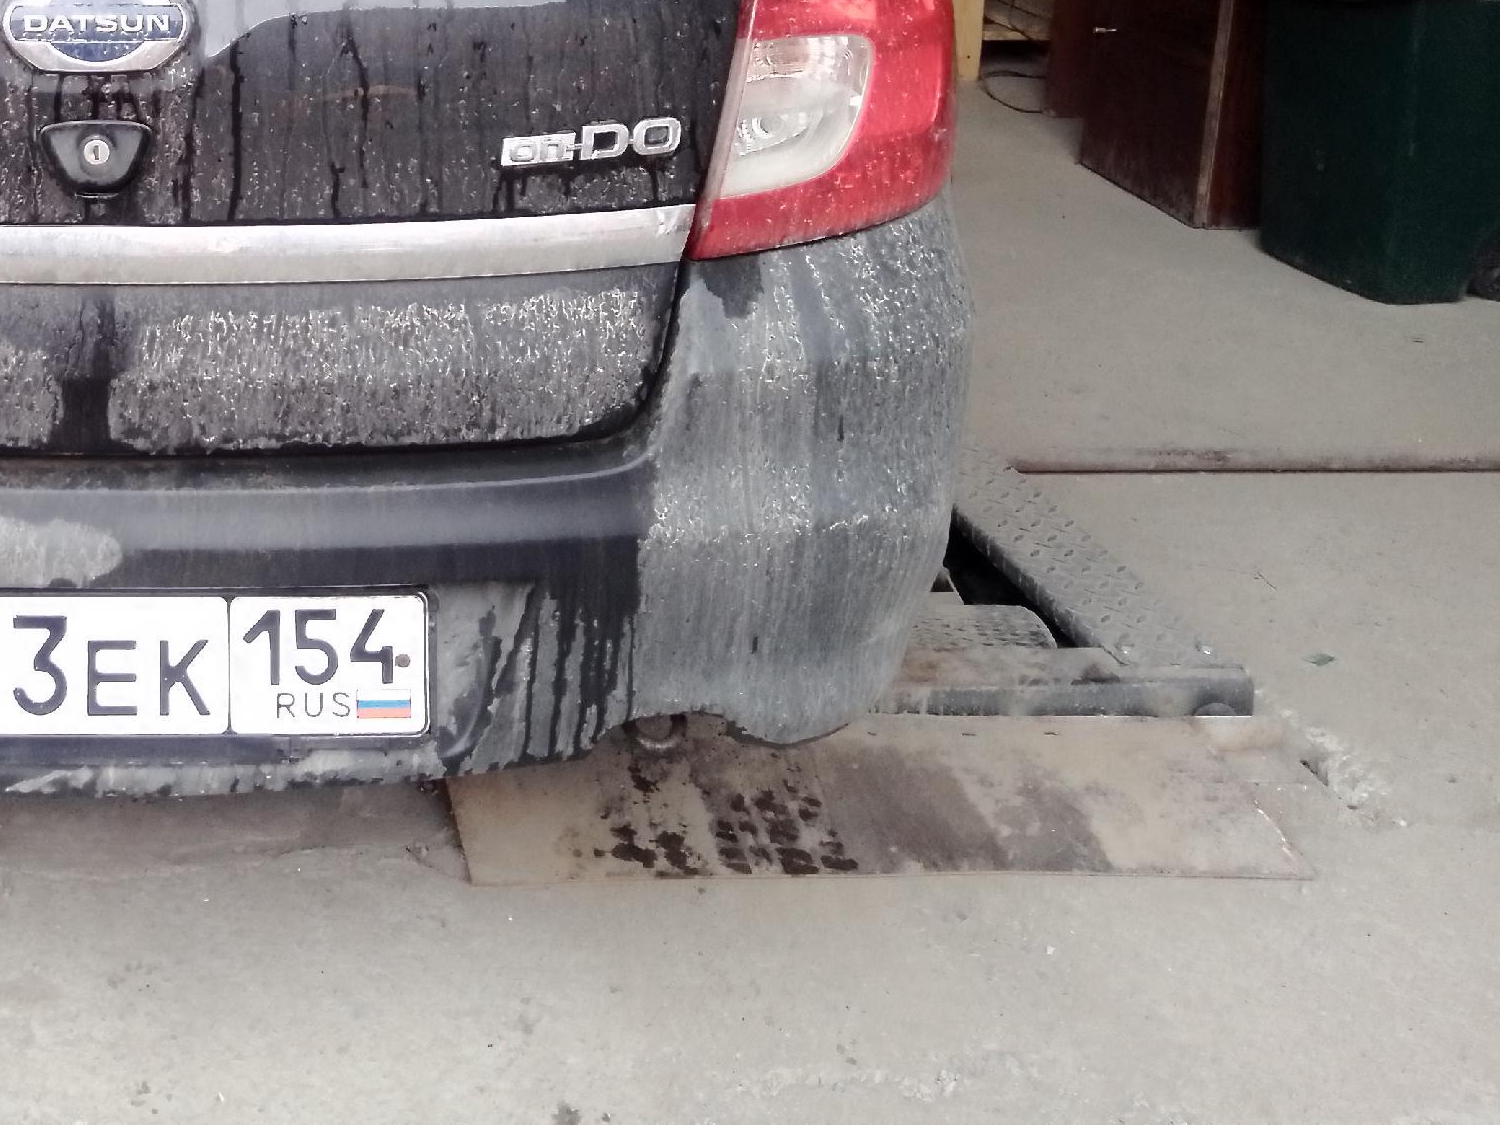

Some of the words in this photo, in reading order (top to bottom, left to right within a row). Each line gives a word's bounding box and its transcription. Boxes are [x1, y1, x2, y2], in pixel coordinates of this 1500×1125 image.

[23, 14, 170, 32] DATSUN
[243, 608, 394, 685] 154
[276, 691, 350, 719] RUS
